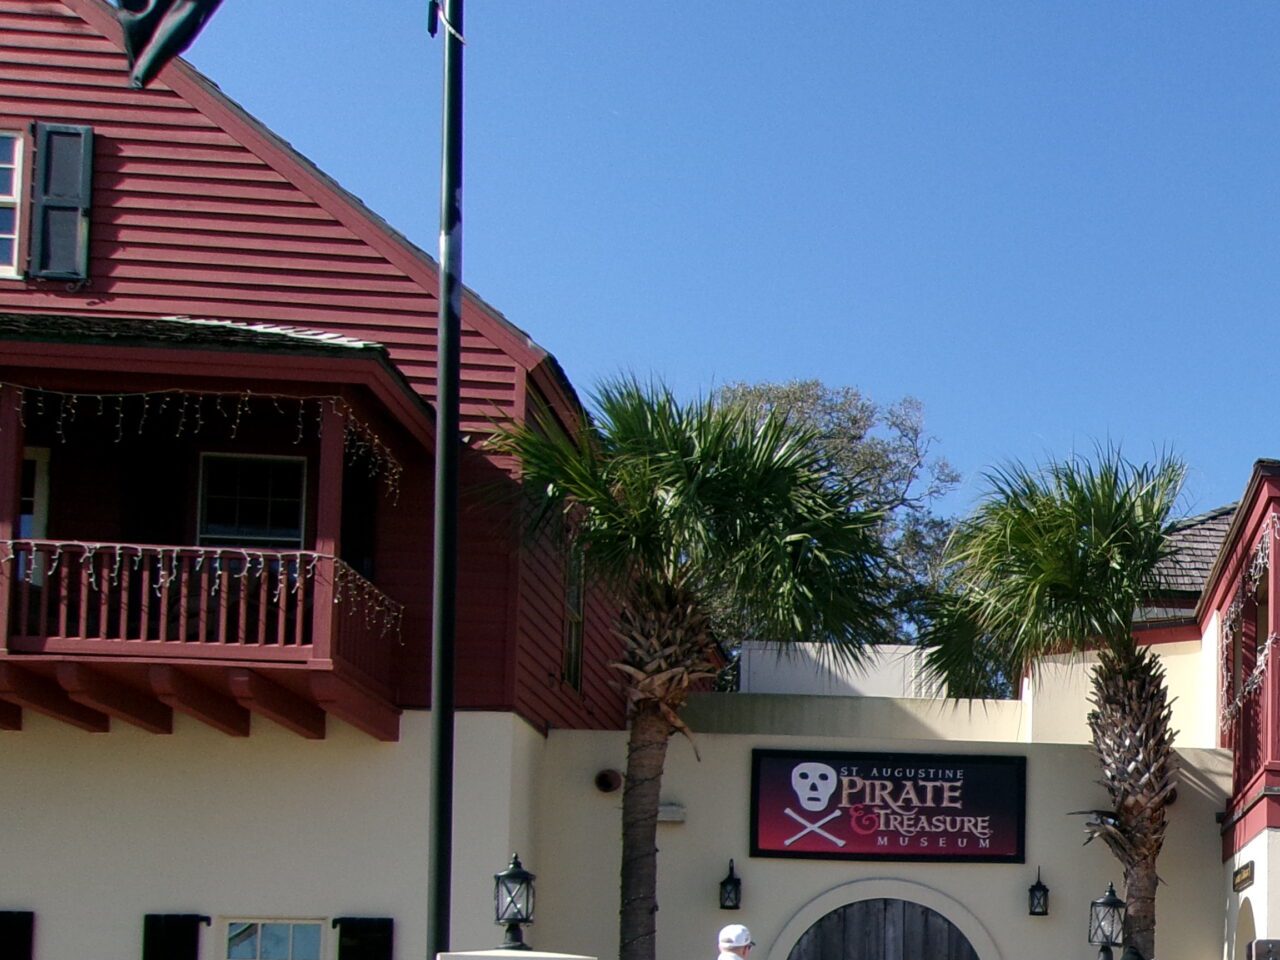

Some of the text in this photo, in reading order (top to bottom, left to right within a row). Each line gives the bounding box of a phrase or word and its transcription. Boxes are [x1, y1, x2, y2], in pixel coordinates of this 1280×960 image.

[840, 766, 964, 779] ST. AUGUSTINE
[838, 776, 963, 813] PIRATE
[849, 804, 991, 838] & TREASURE
[877, 837, 990, 848] MUSEUM
